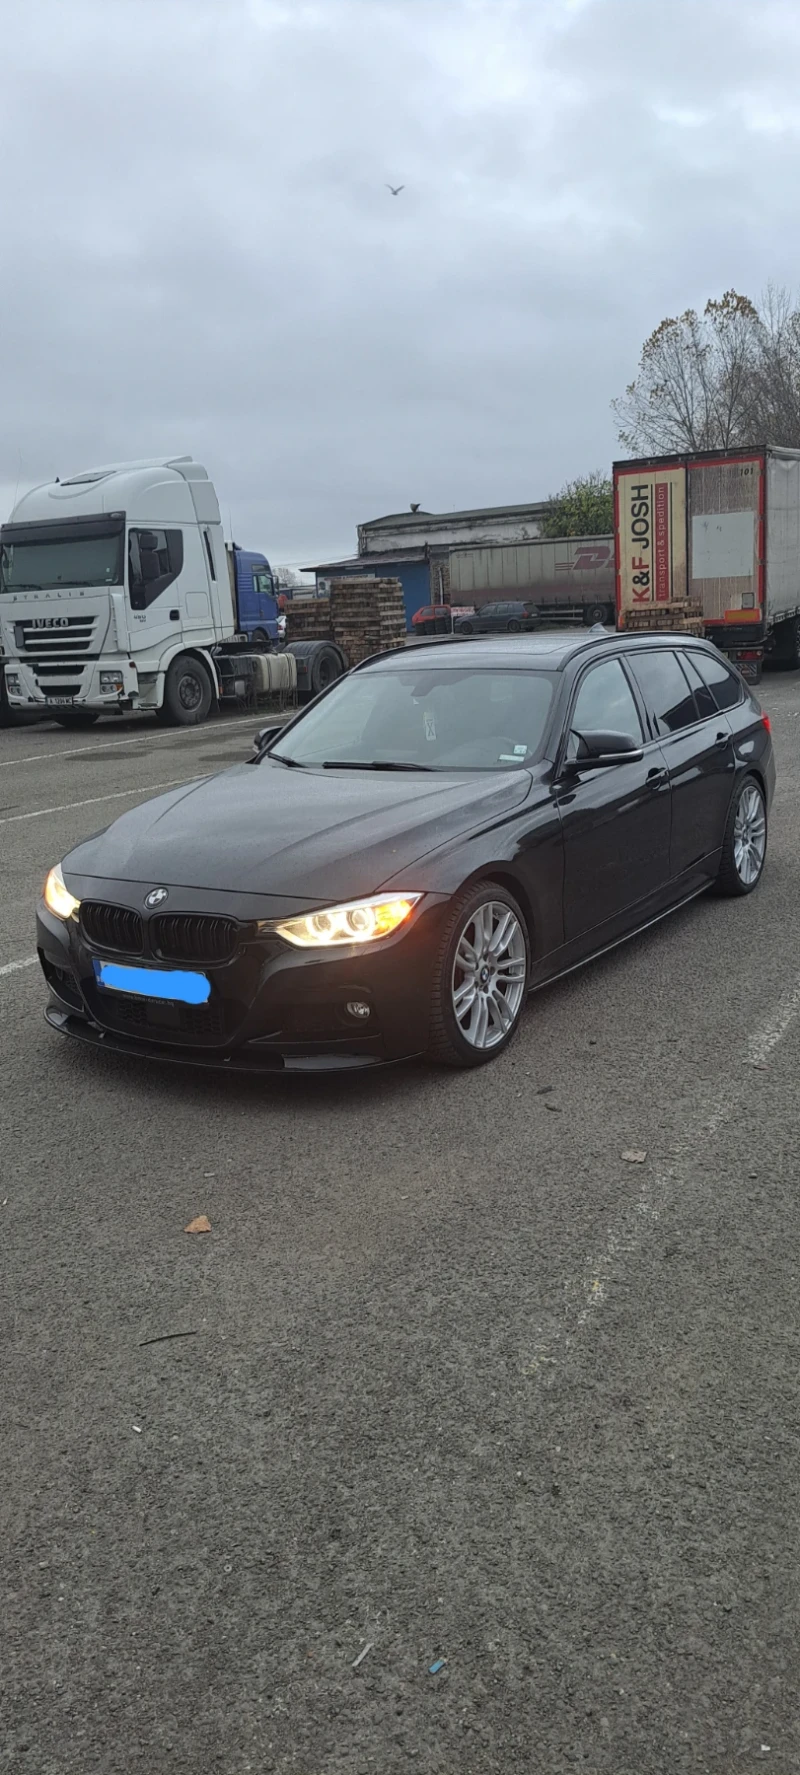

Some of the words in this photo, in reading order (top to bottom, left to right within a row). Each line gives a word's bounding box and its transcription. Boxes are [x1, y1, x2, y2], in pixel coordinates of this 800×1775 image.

[740, 467, 754, 476] 101
[630, 484, 650, 550] JOSH
[656, 486, 668, 536] spedition
[656, 538, 665, 547] &
[632, 556, 651, 603] K&F
[657, 549, 668, 597] transport
[32, 617, 69, 629] IVECO
